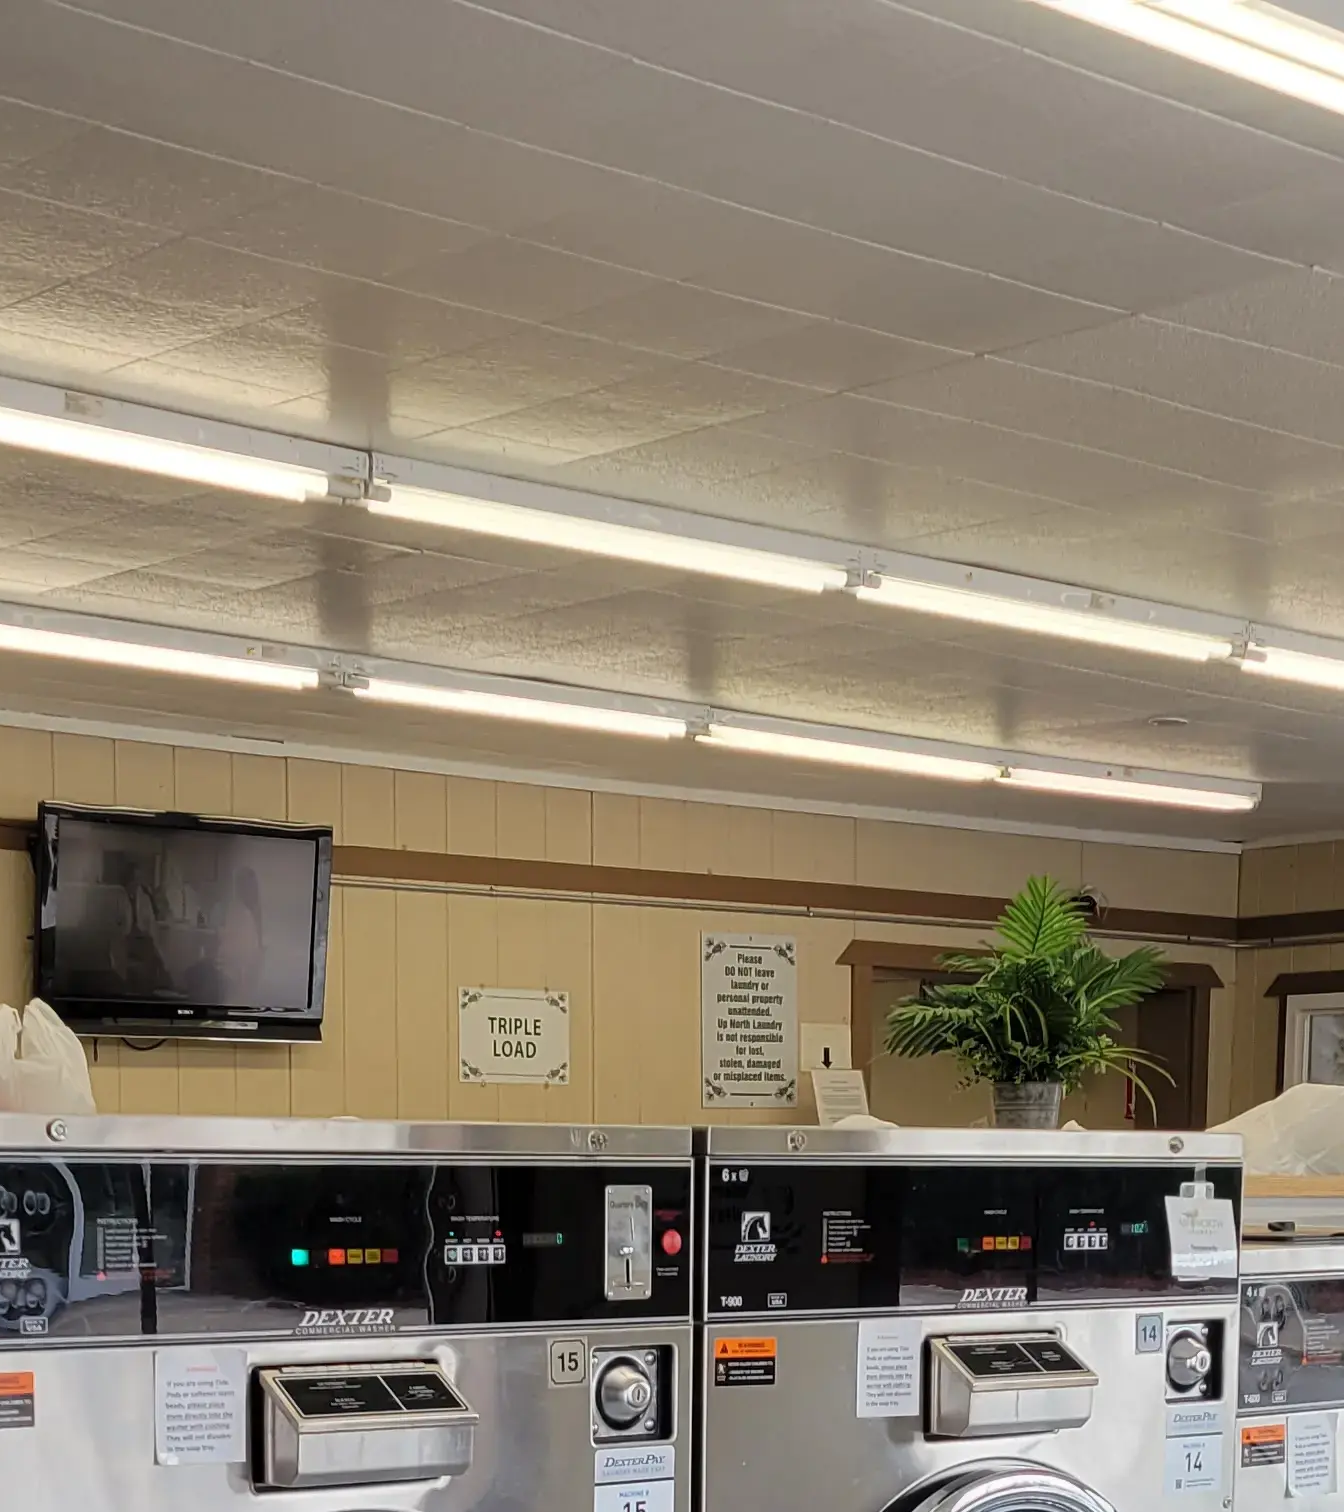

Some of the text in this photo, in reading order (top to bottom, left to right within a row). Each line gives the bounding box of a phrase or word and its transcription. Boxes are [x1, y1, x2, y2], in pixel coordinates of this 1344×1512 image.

[737, 953, 762, 964] Please
[725, 966, 774, 978] DO NOT leave
[731, 980, 769, 991] laundry or
[717, 993, 783, 1005] personal property
[487, 1016, 542, 1036] TRIPLE
[718, 1019, 782, 1031] Up North Laundry
[726, 1033, 738, 1042] not
[740, 1033, 783, 1043] responsible
[493, 1040, 537, 1058] LOAD
[736, 1046, 746, 1055] for
[747, 1059, 781, 1070] damaged
[713, 1073, 721, 1081] or
[724, 1072, 762, 1082] misplaced
[722, 1169, 730, 1182] 6
[735, 1244, 776, 1254] DEXTER
[734, 1254, 777, 1262] LAUNDRY
[960, 1287, 1028, 1302] DEXTER
[299, 1308, 395, 1326] DEXTER
[295, 1324, 397, 1335] COMMERCIAL WASHER
[1141, 1325, 1156, 1343] 14
[1252, 1349, 1283, 1357] DEXTER
[557, 1351, 579, 1372] 15
[1184, 1451, 1203, 1473] 14
